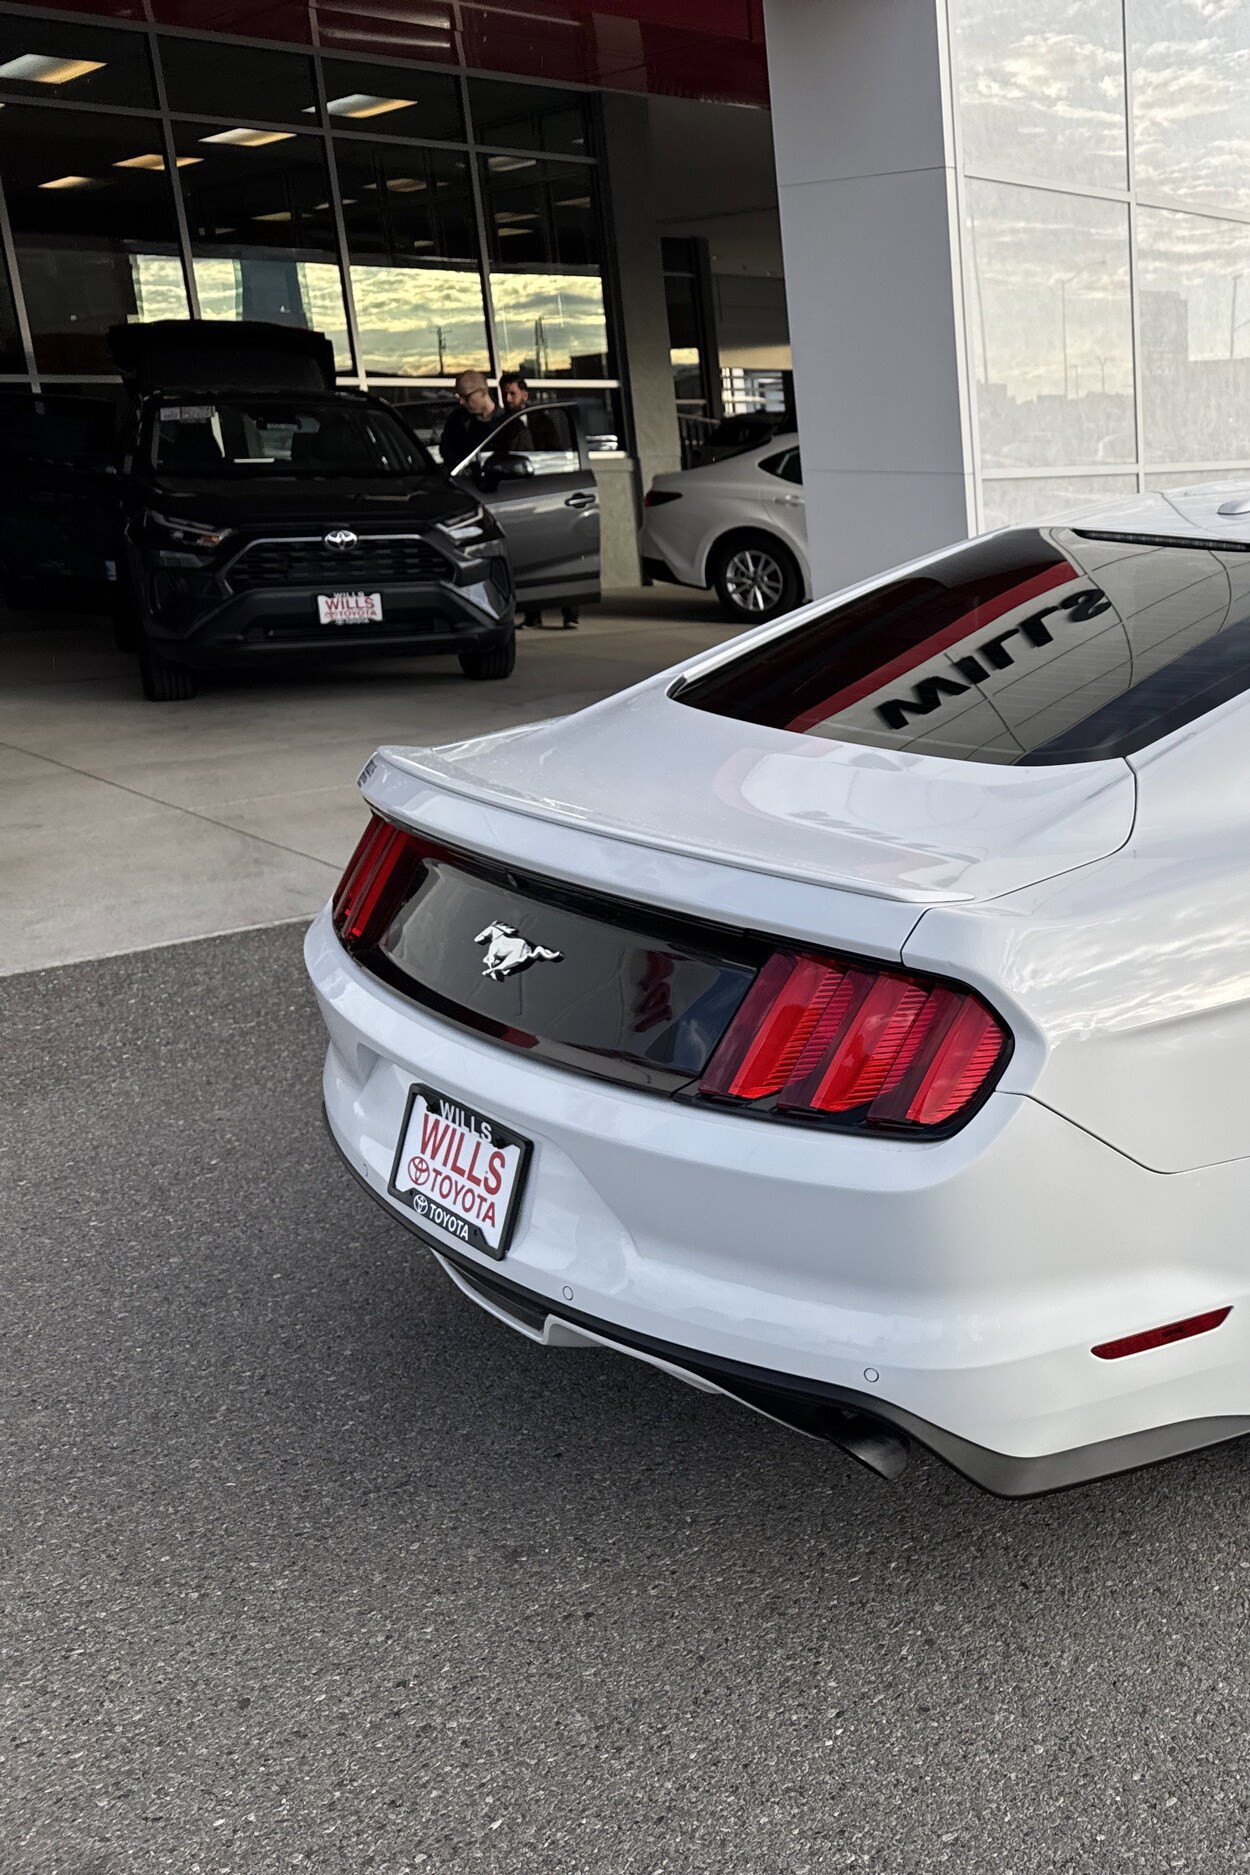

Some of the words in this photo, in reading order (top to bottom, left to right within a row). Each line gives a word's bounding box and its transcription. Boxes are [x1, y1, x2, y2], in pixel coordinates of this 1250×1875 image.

[325, 597, 375, 610] WILLS
[339, 609, 377, 618] TOYOTA
[440, 1099, 492, 1143] WILLS
[420, 1113, 506, 1196] WILLS
[431, 1168, 496, 1228] TOYOTA
[429, 1203, 469, 1241] TOYOTA
